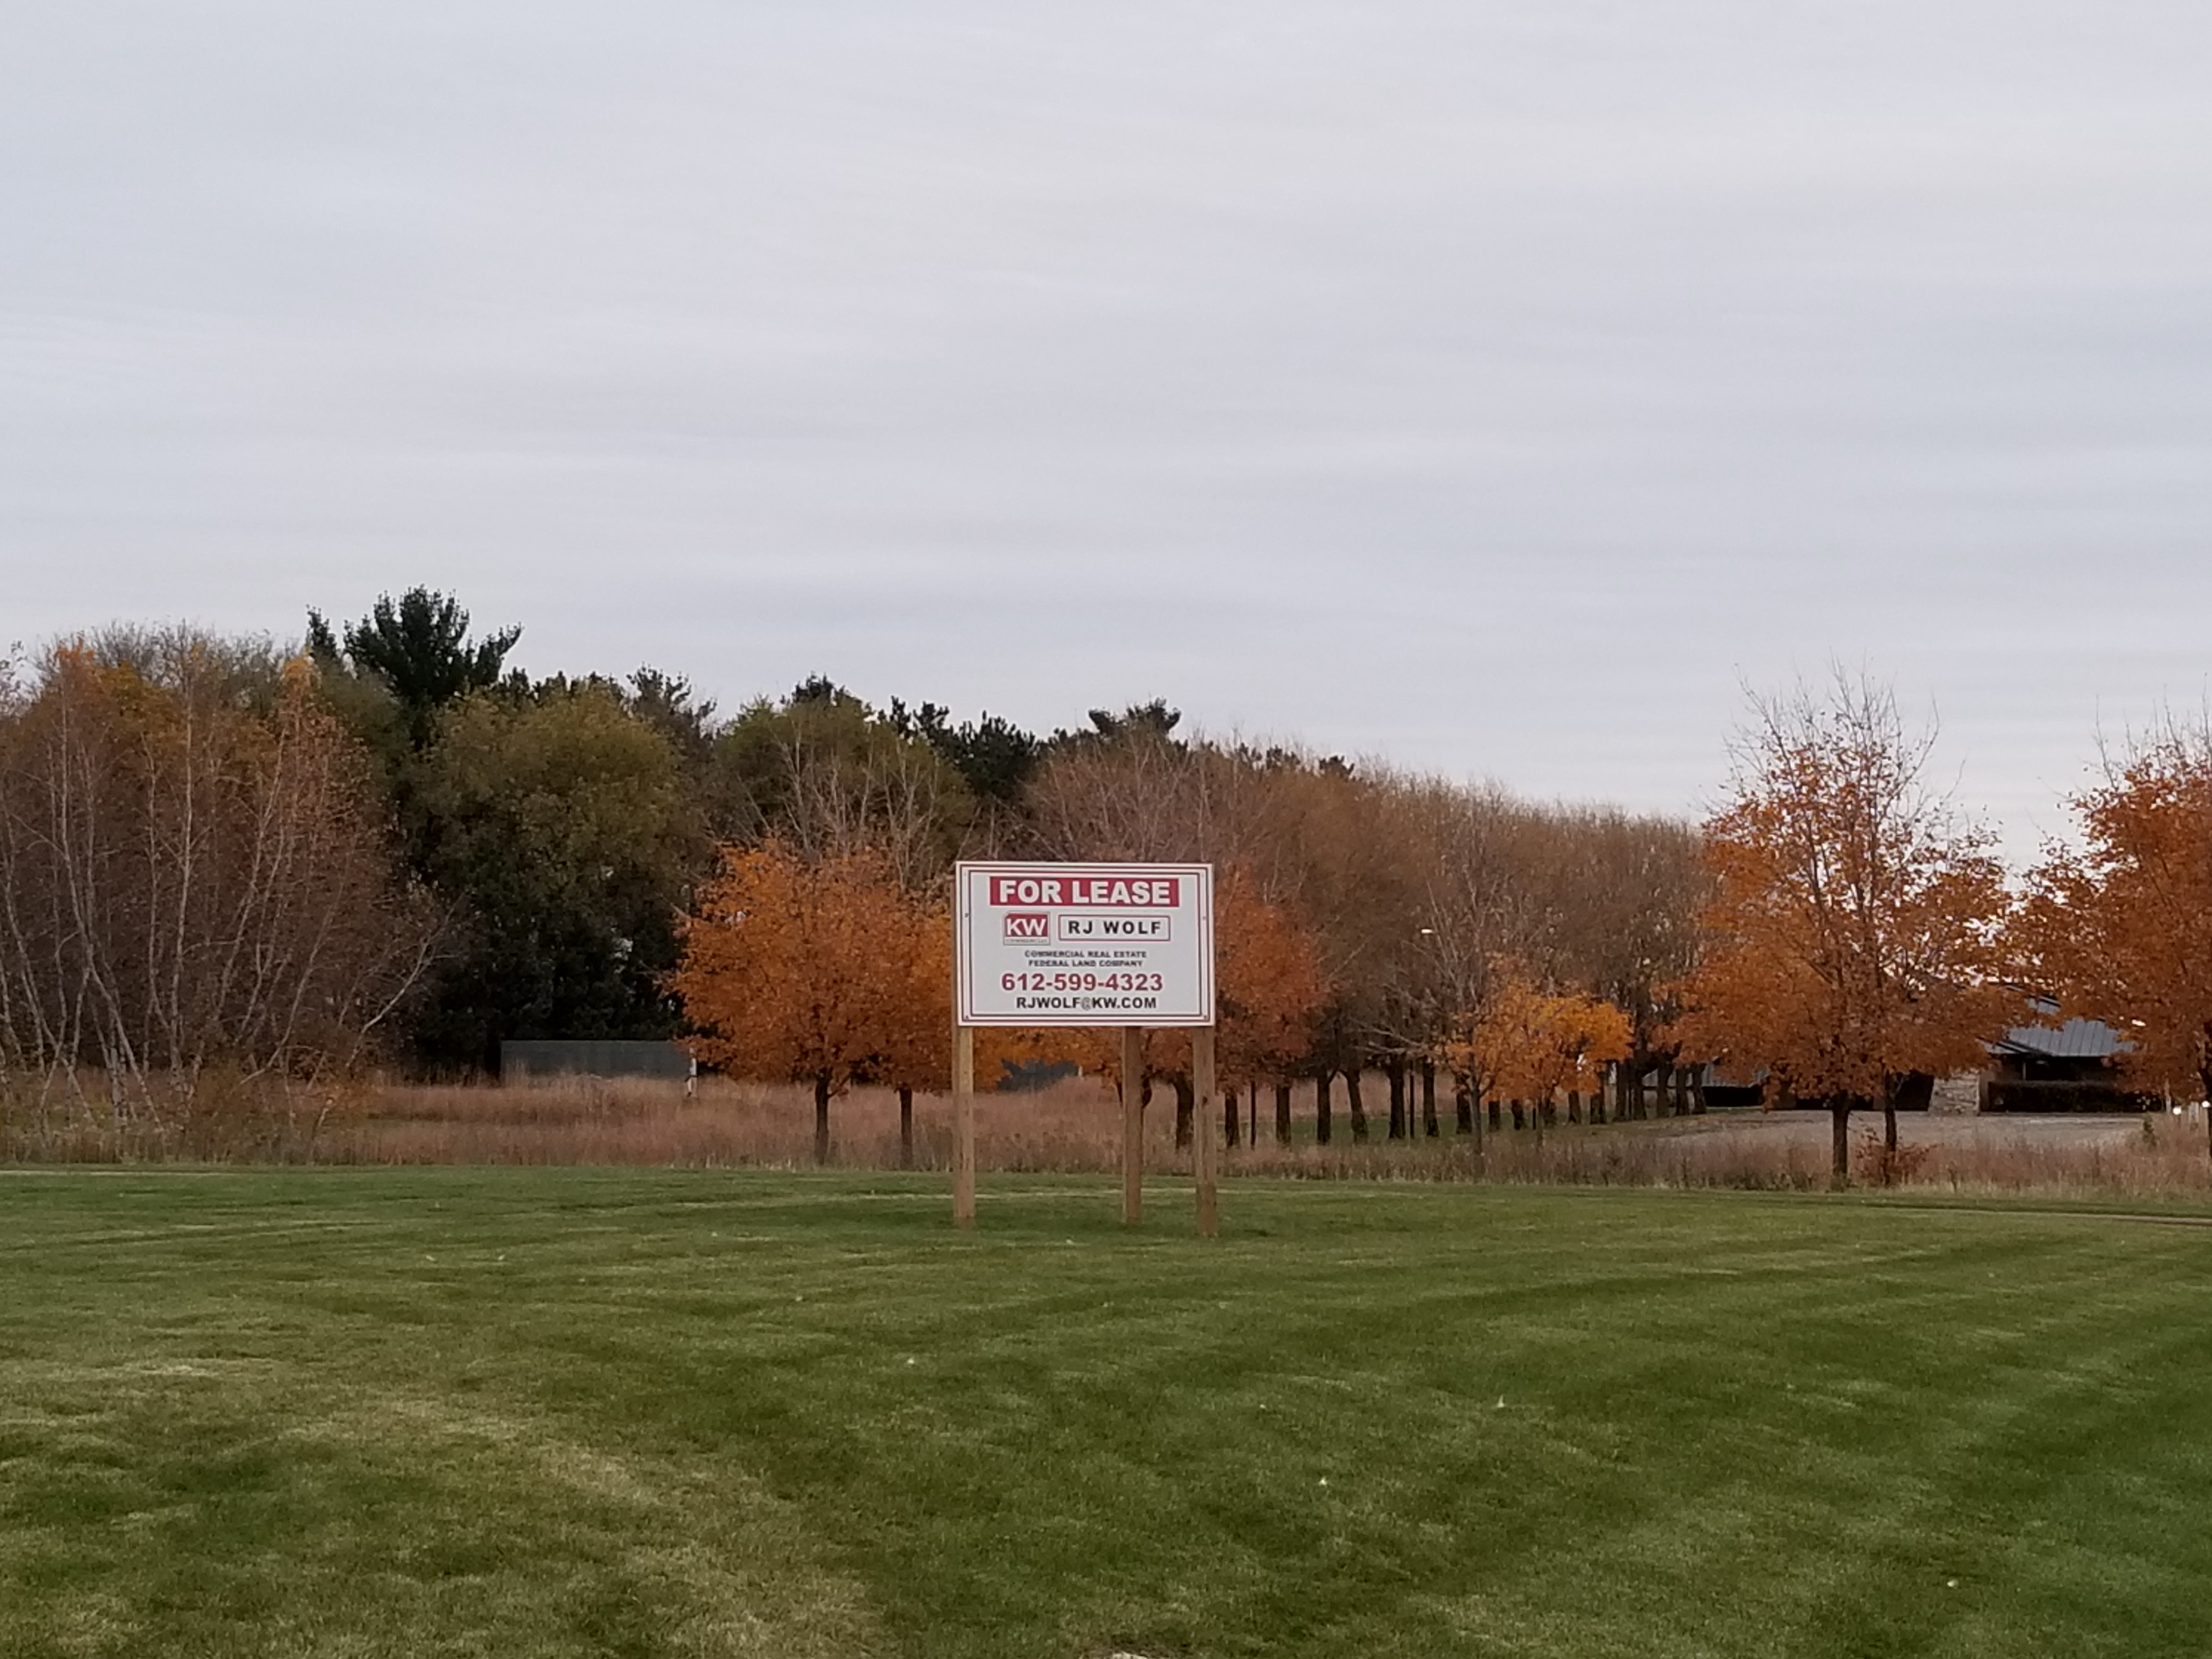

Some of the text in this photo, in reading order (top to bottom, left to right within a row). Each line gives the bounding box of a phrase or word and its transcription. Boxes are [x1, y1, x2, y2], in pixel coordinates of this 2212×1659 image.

[1000, 880, 1171, 904] FOR LEASE
[1006, 918, 1047, 936] KW
[1068, 921, 1161, 934] RJ WOLF
[1001, 973, 1164, 991] 612-599-4323
[1016, 998, 1156, 1010] RJWOLF@KW.COM
